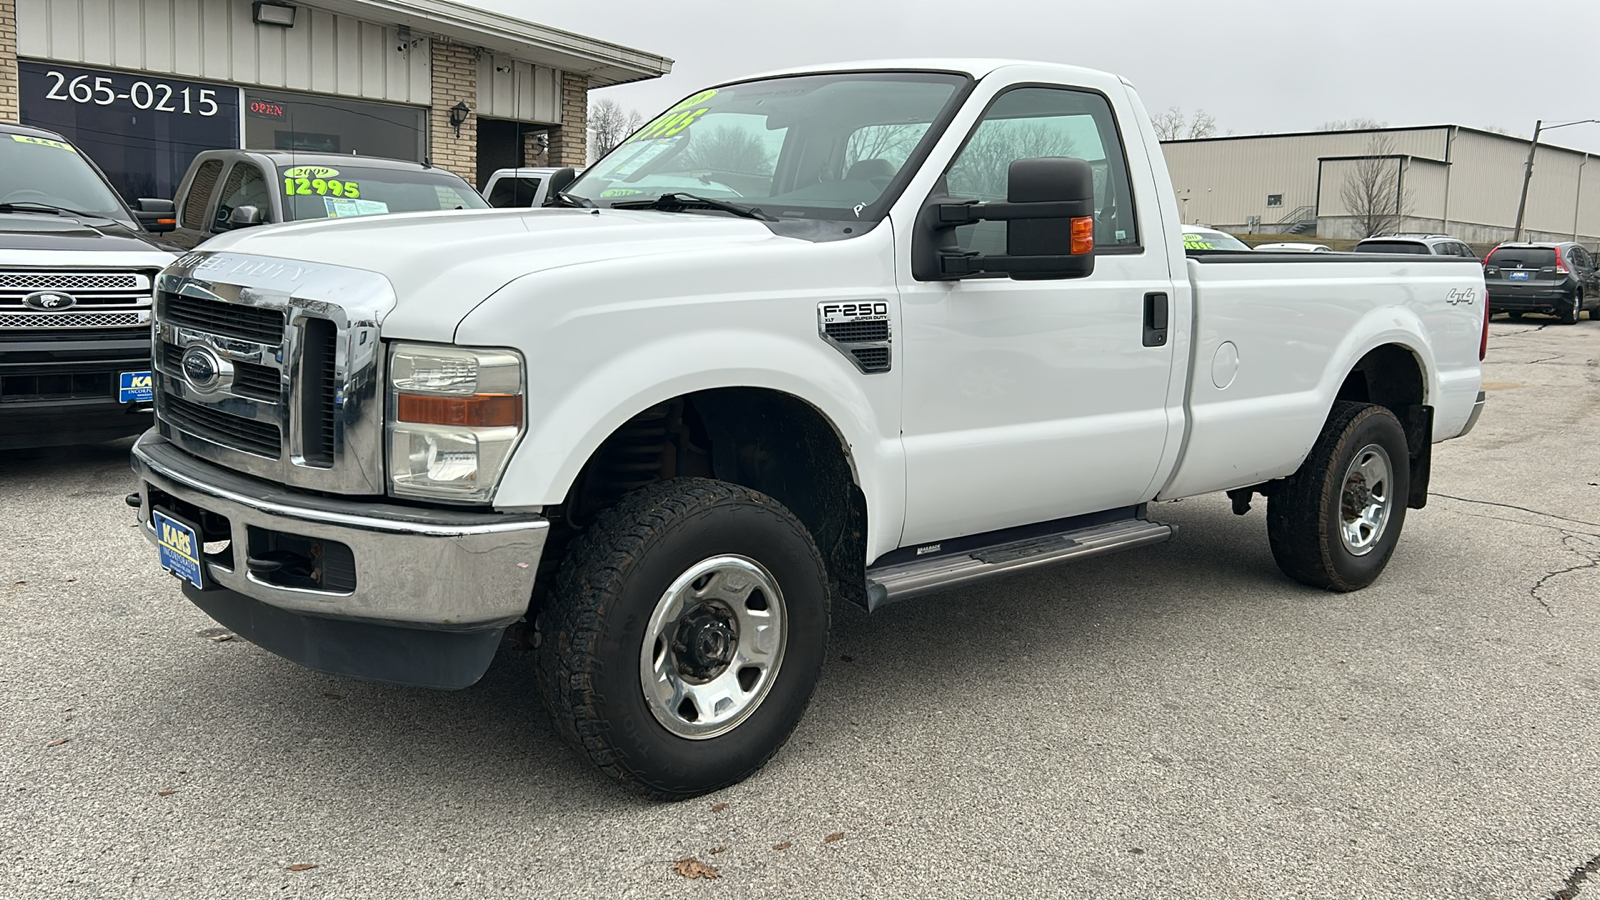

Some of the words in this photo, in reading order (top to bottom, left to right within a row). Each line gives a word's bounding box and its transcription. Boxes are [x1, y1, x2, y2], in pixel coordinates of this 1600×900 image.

[45, 71, 218, 116] 265-0215
[250, 101, 283, 117] OPEN
[295, 168, 329, 177] 2009
[284, 178, 360, 198] 12995
[162, 522, 191, 555] KARS
